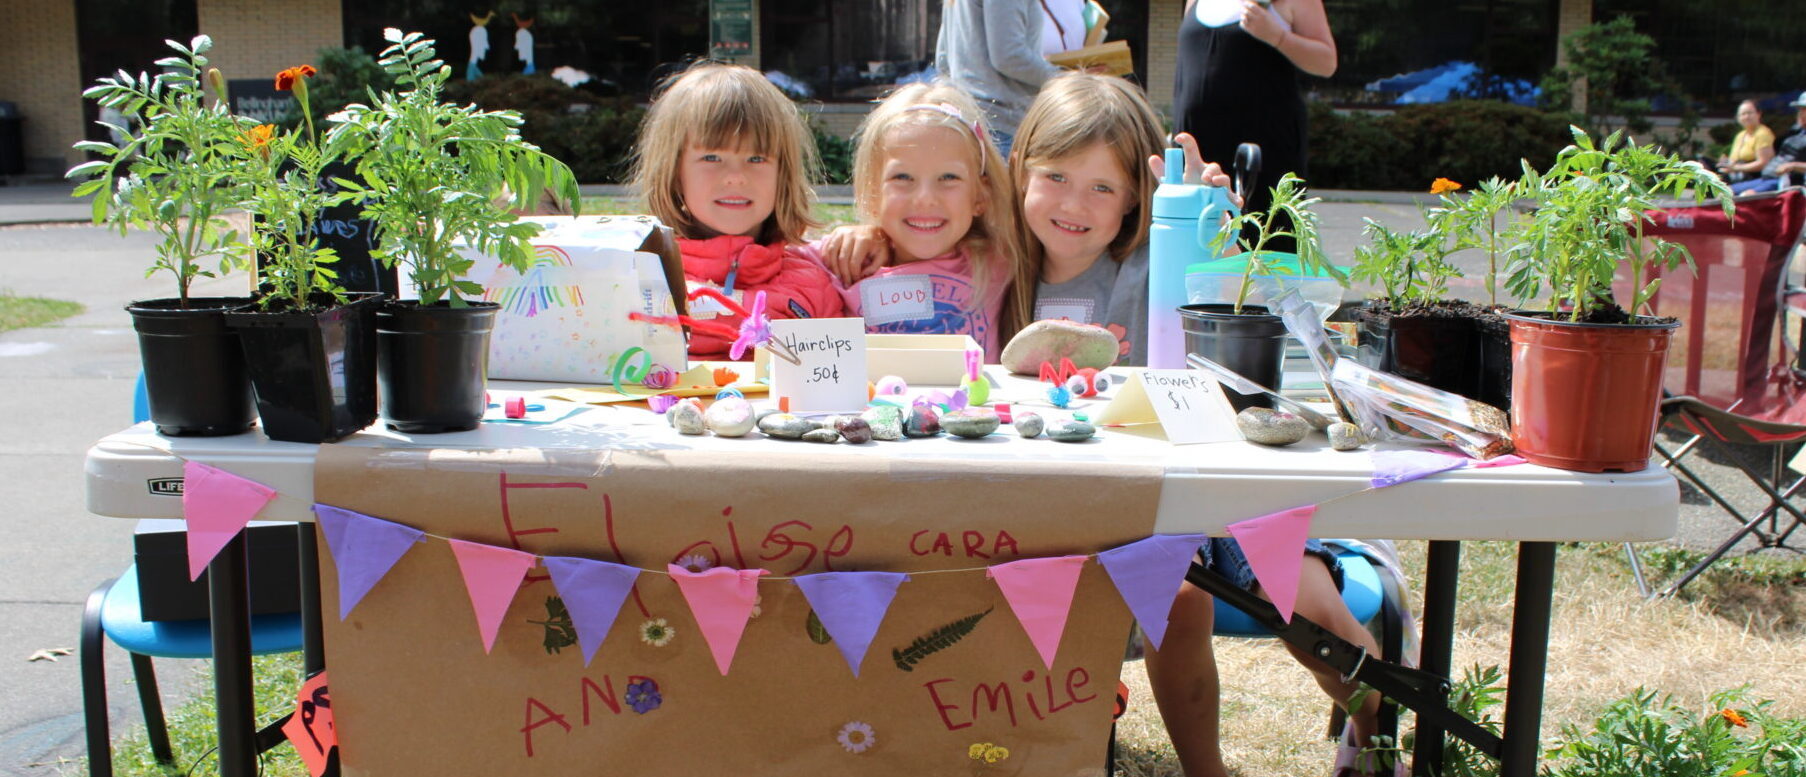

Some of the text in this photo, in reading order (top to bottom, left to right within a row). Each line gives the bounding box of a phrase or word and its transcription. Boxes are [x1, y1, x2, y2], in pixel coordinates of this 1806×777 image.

[786, 332, 852, 358] Hairclips
[806, 364, 839, 384] .50¢
[1143, 372, 1209, 393] Flowers
[1168, 390, 1190, 411] $1
[909, 529, 1019, 559] CARA
